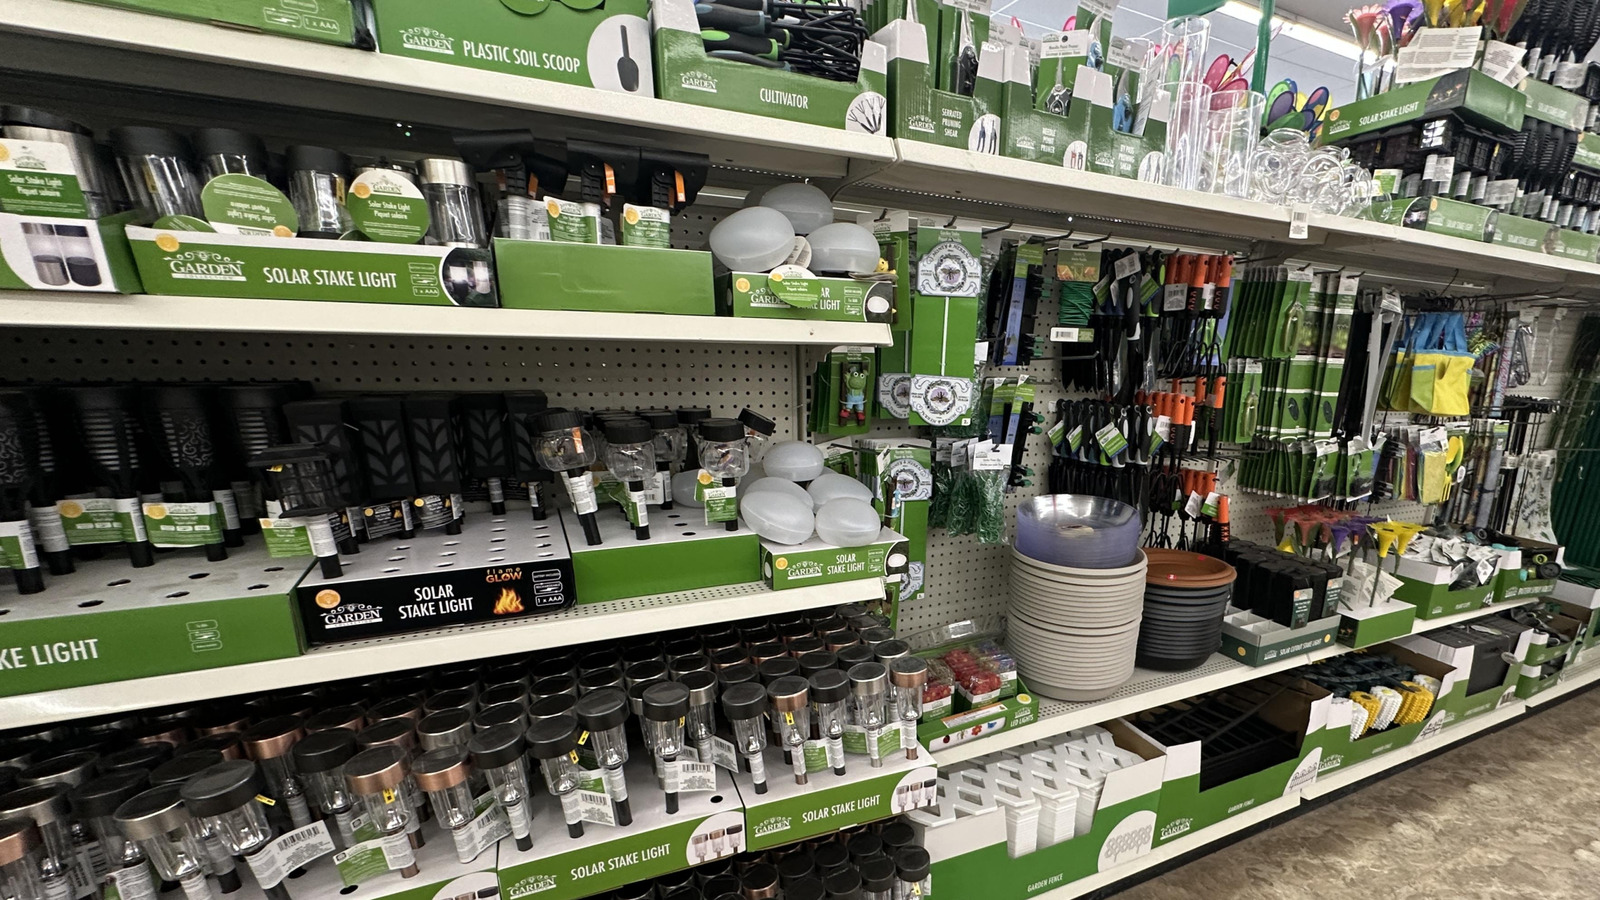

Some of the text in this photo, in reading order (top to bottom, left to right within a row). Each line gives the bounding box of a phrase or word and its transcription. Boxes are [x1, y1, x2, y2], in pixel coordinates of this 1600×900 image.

[403, 33, 452, 50] GARDEN
[463, 40, 580, 73] PLASTIC SOIL SCOOP
[682, 76, 717, 90] GARDEN
[760, 88, 808, 109] CULTIVATOR
[942, 108, 962, 119] SERRATED
[1359, 101, 1420, 126] SOLAR STAKE LIGHT
[942, 118, 961, 129] PRUNING
[944, 128, 958, 138] SHEAR
[373, 184, 402, 194] GARDEN
[368, 200, 411, 212] Solar Stake Light
[374, 210, 390, 219] Piquet
[170, 260, 243, 276] GARDEN
[263, 266, 397, 288] SOLAR STAKE LIGHT
[820, 300, 840, 310] LIGHT
[836, 553, 856, 564] SOLAR
[487, 567, 521, 575] flame
[788, 566, 822, 578] GARDEN
[827, 563, 846, 575] STAKE
[847, 561, 865, 573] LIGHT
[486, 571, 522, 583] GLOW
[414, 584, 455, 602] SOLAR
[398, 597, 474, 620] STAKE LIGHT
[325, 610, 380, 625] GARDEN
[31, 639, 99, 666] LIGHT
[1010, 713, 1034, 728] LED LIGHTS
[802, 794, 881, 824] SOLAR STAKE LIGHT
[755, 819, 791, 835] GARDEN
[570, 843, 671, 881] SOLAR STAKE LIGHT
[510, 876, 556, 897] GARDEN
[1027, 872, 1064, 892] GARDEN FENCE
